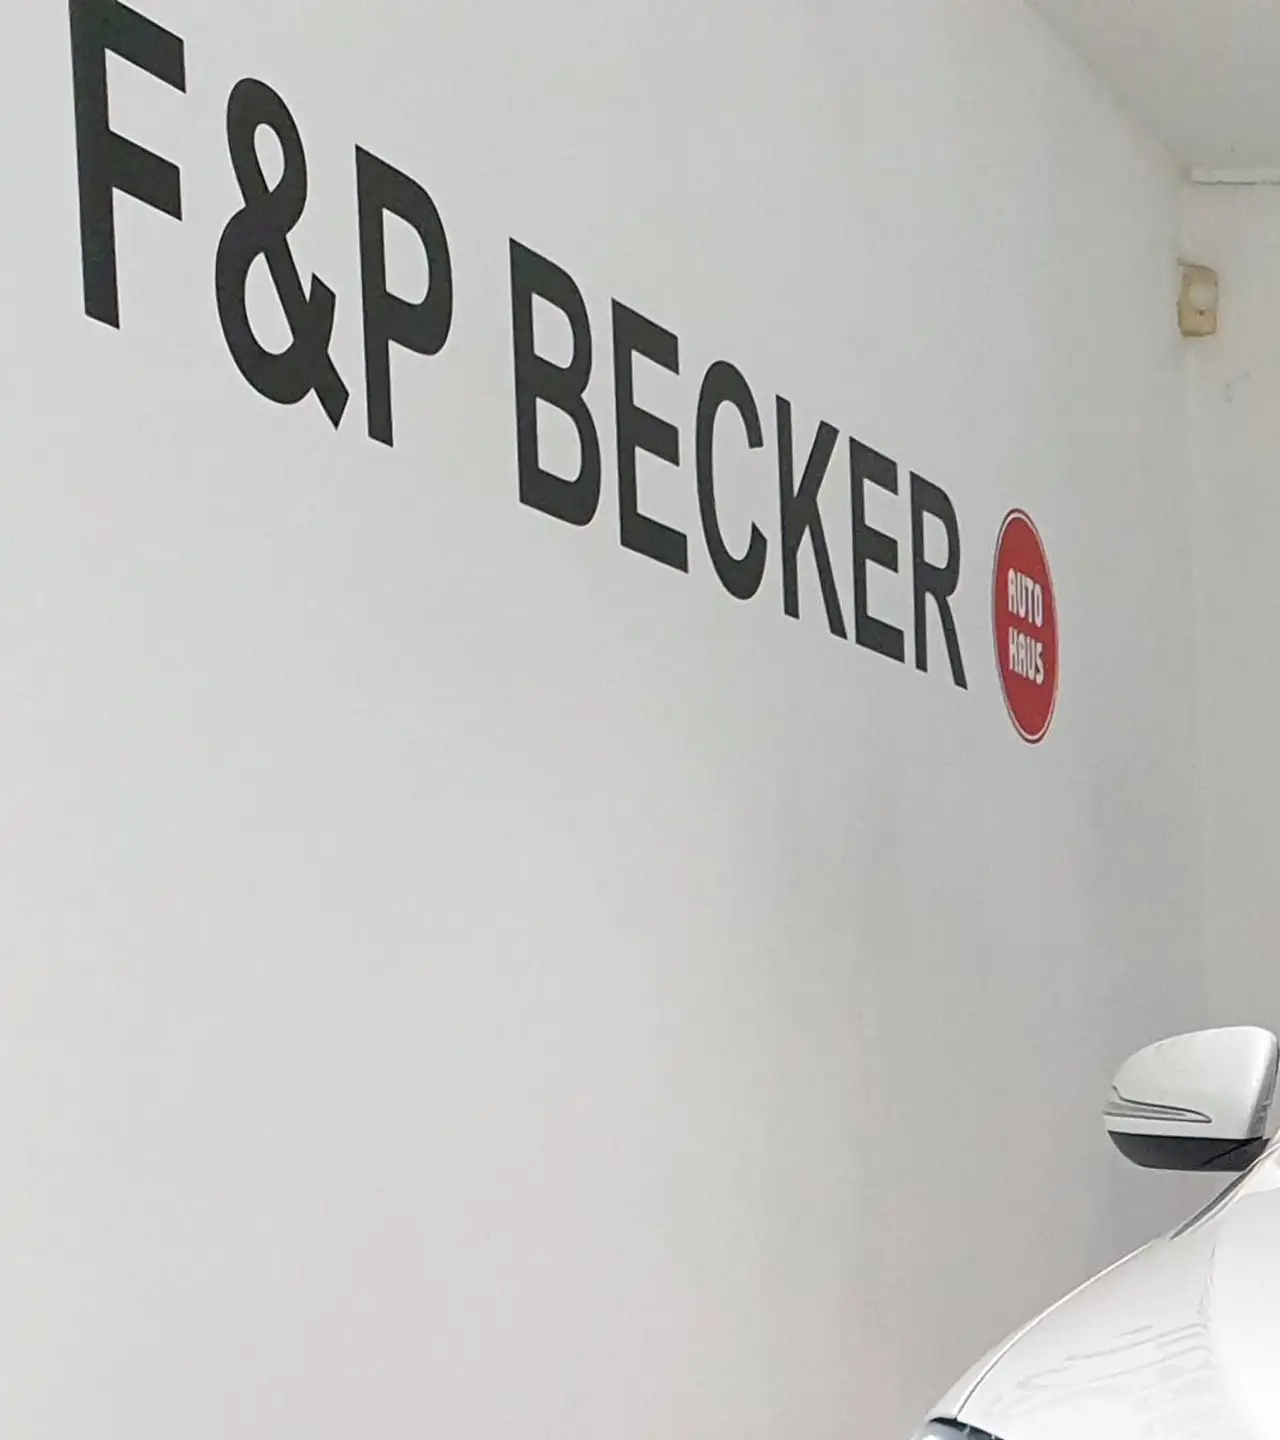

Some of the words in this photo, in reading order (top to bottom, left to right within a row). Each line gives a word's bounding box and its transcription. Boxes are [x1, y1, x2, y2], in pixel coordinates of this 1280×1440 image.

[69, 0, 453, 448] F&P
[508, 236, 968, 690] BECKER
[1008, 567, 1043, 628] AUTO
[1008, 626, 1045, 686] HAUS
